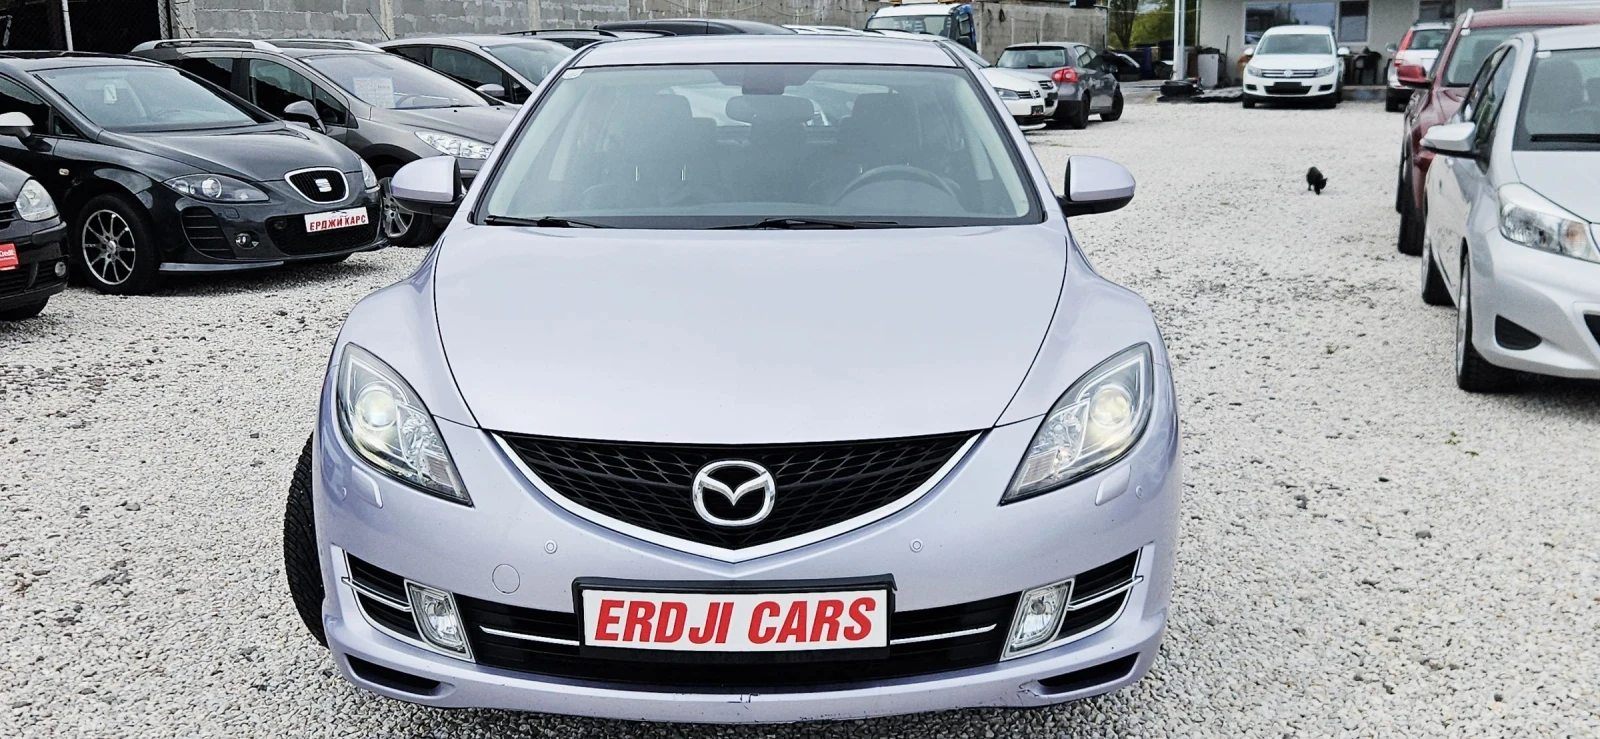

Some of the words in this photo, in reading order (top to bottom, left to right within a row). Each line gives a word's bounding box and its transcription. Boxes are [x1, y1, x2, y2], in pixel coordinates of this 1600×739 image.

[309, 218, 343, 231] ЕРДЖИ
[344, 214, 366, 226] КАРС
[594, 599, 734, 644] ERDJI
[747, 597, 876, 645] CARS
